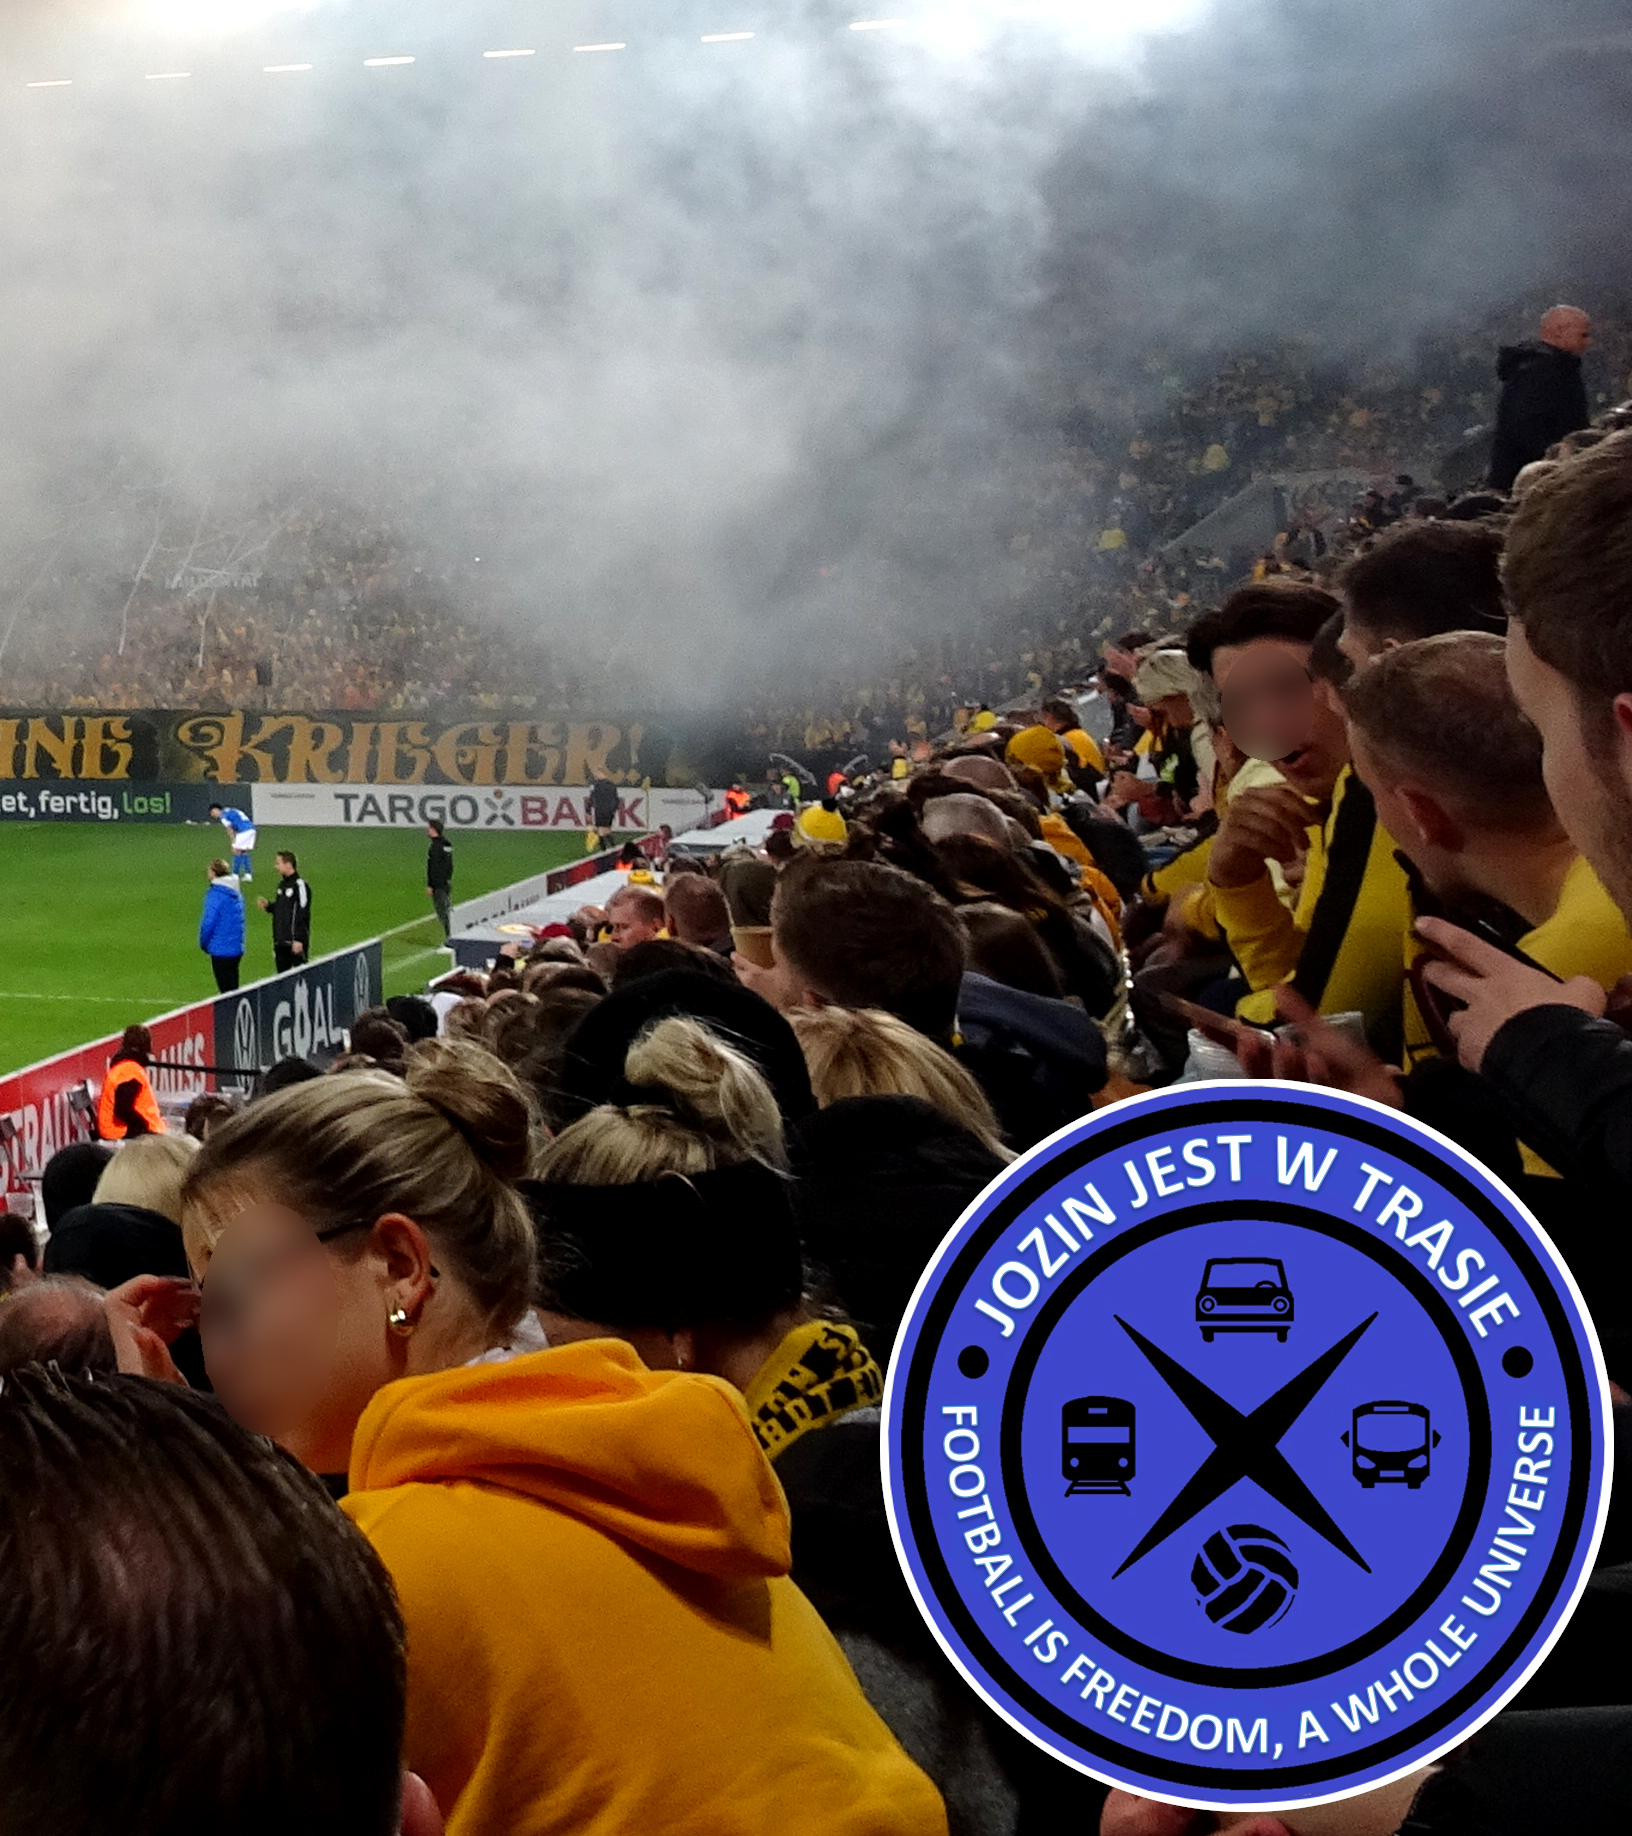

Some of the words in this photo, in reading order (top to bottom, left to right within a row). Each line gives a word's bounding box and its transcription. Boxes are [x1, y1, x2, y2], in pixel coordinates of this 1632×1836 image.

[178, 710, 644, 785] KRIEGER!
[39, 790, 119, 820] fertig,
[122, 792, 171, 814] los!
[520, 795, 646, 828] BAK
